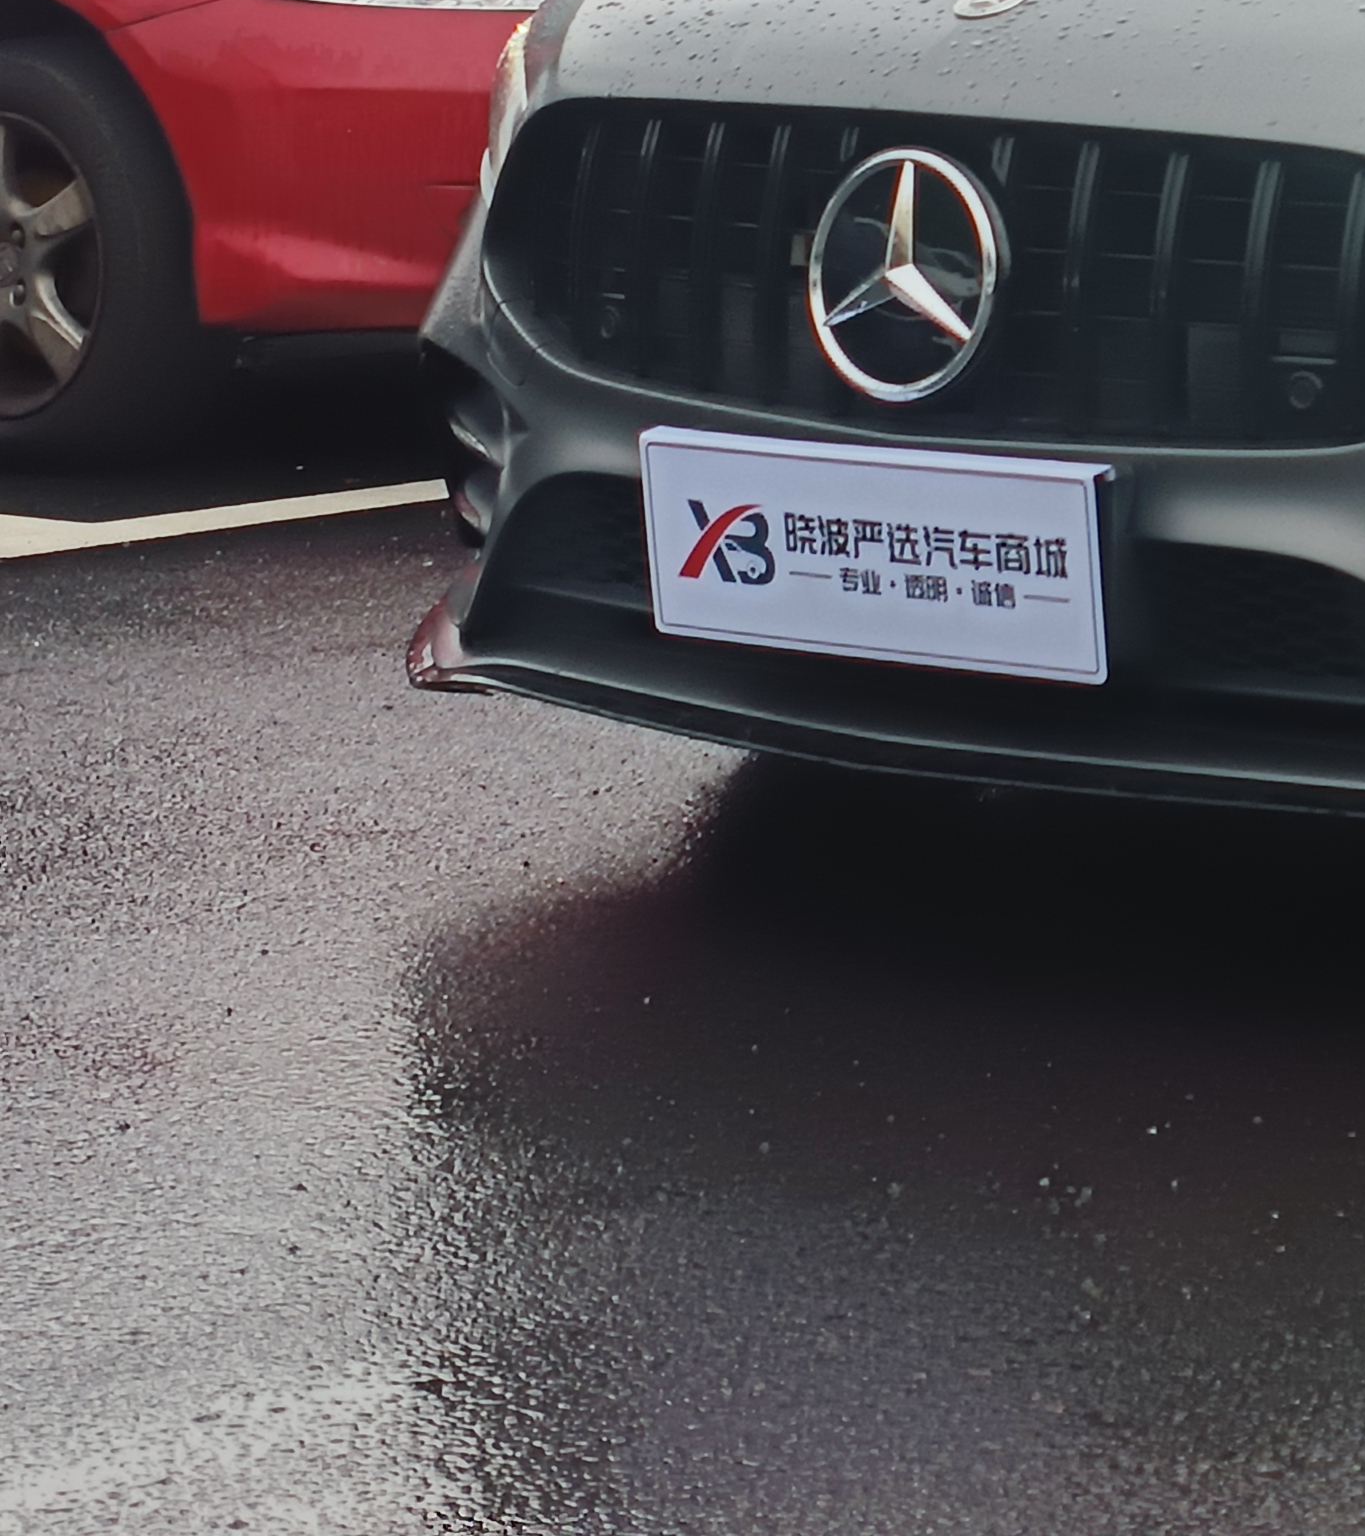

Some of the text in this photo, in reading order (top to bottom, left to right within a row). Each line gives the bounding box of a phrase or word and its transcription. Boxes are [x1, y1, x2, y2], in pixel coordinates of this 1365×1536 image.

[783, 511, 1069, 579] 晓波严选汽车商城
